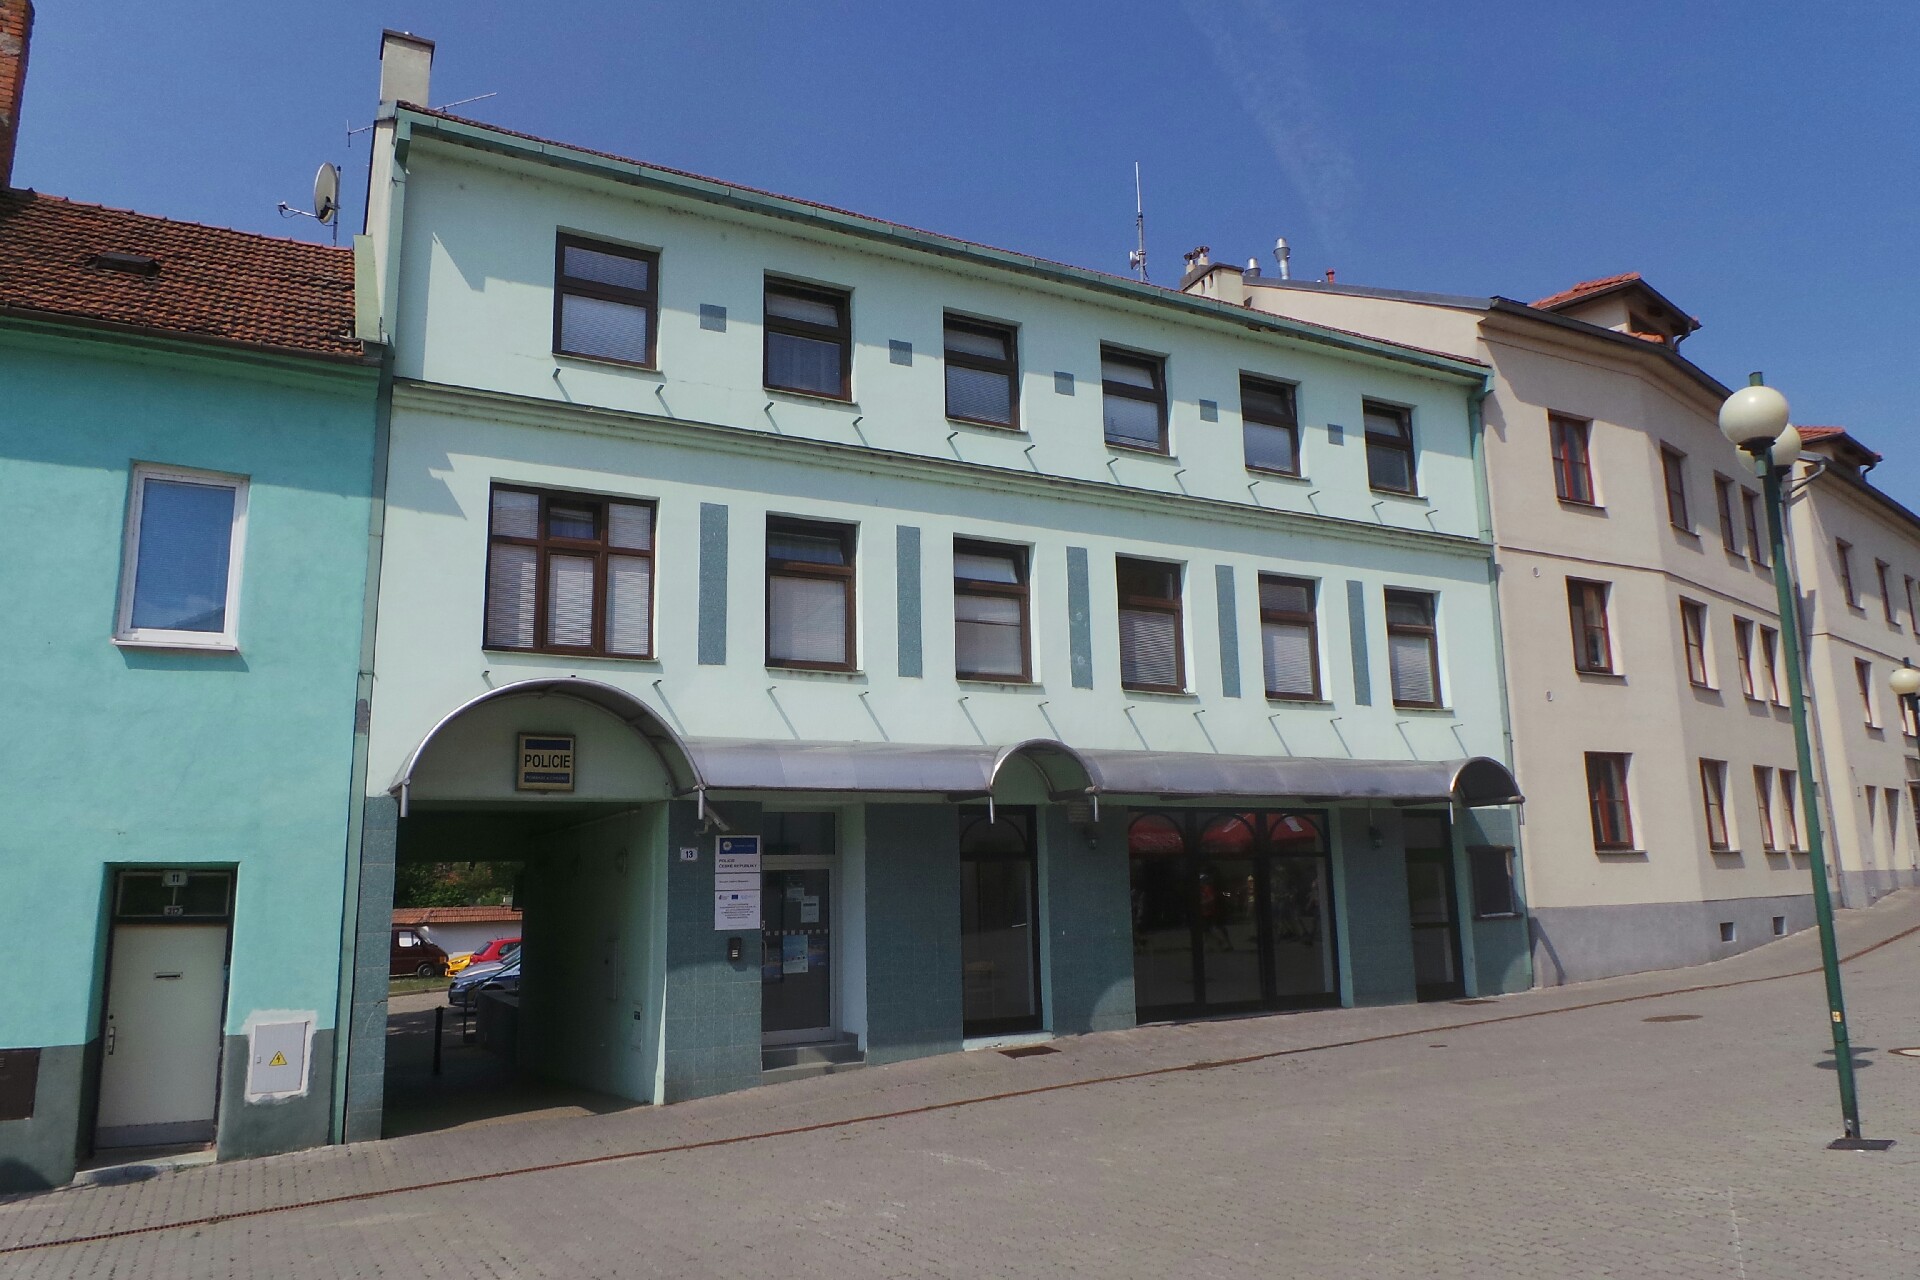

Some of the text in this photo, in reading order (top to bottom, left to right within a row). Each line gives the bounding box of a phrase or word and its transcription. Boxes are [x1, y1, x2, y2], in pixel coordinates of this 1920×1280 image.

[524, 754, 570, 768] POLICIE
[685, 850, 694, 859] 13
[172, 874, 179, 883] 11
